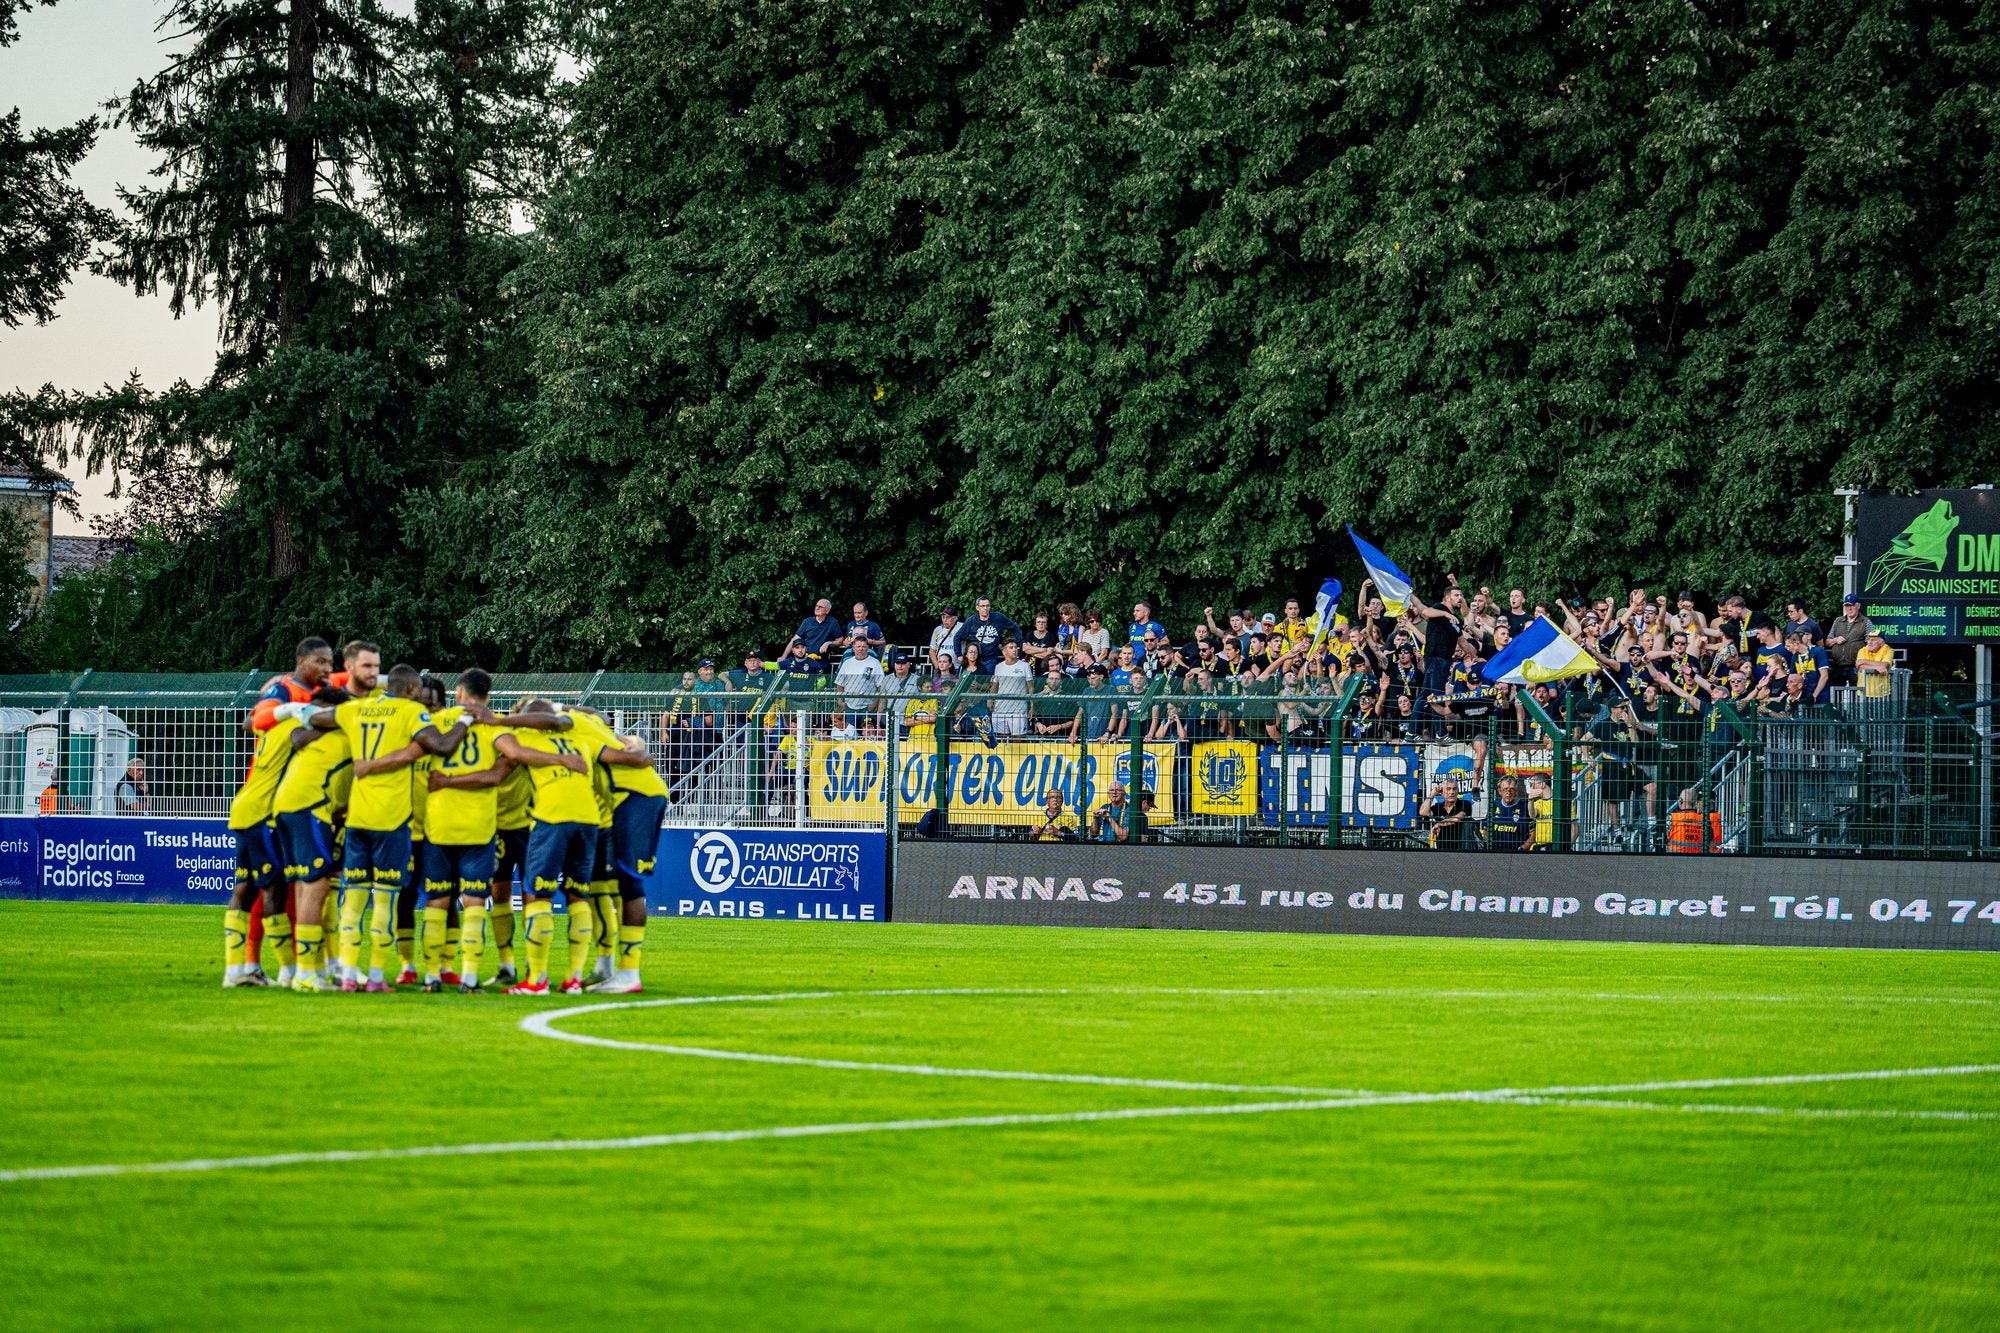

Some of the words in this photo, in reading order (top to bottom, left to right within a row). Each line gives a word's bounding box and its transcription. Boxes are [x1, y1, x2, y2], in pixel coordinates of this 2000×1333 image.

[1900, 578, 2000, 594] ASSAINISSEME
[1866, 604, 1912, 617] DÉBOUCHAGE
[1918, 606, 1947, 618] CURAGE
[1965, 604, 2000, 618] DÉSINFEC
[1906, 625, 1947, 636] DIAGNOSTIC
[361, 722, 386, 761] 17
[823, 750, 1005, 806] SUPORTER
[1014, 754, 1097, 816] CLUB
[143, 831, 189, 848] Tissus
[192, 831, 236, 848] Haute
[44, 838, 136, 866] Beglarian
[742, 842, 860, 863] TRANSPORTS
[43, 865, 113, 888] Fabrics
[116, 870, 145, 882] France
[187, 876, 222, 890] 69400
[740, 865, 834, 887] CADILLAT
[948, 875, 1124, 902] ARNAS
[1163, 882, 1246, 905] 451
[1260, 890, 1334, 907] rue
[1348, 887, 1404, 909] du
[1418, 889, 1580, 918] Champ
[1594, 893, 1728, 918] Garet
[1769, 895, 1853, 920] Tél.
[1869, 898, 1932, 922] 04
[1948, 900, 2000, 923] 74
[678, 899, 765, 918] PARIS
[797, 902, 875, 921] LILLE
